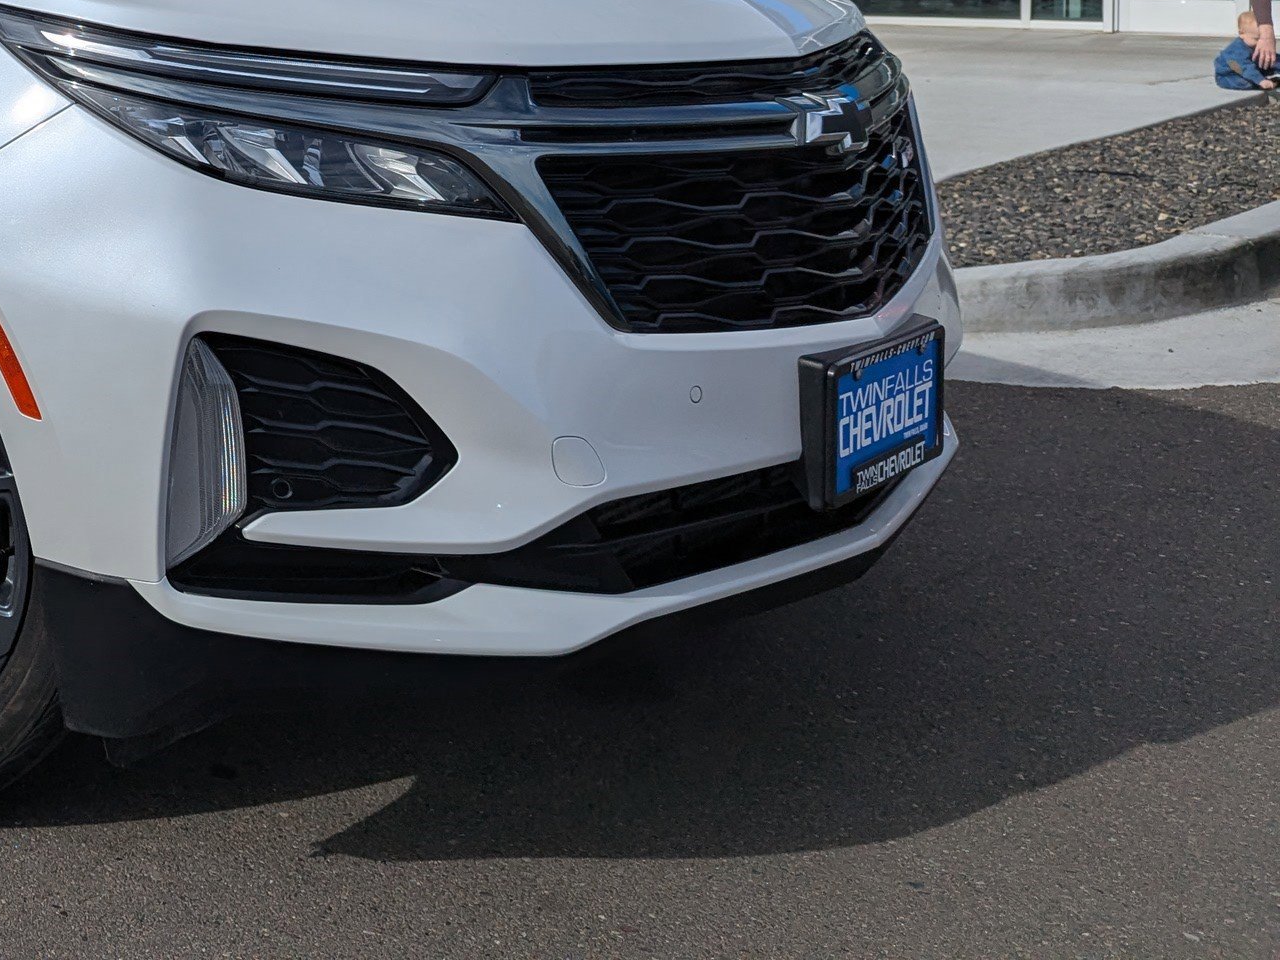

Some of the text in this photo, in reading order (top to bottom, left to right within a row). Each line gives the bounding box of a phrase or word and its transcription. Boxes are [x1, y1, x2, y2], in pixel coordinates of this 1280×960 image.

[838, 358, 934, 417] TWINFALLS
[838, 380, 934, 459] CHEVROLET
[856, 440, 926, 485] TWIN CHEVROLET
[856, 475, 878, 494] FALLS
